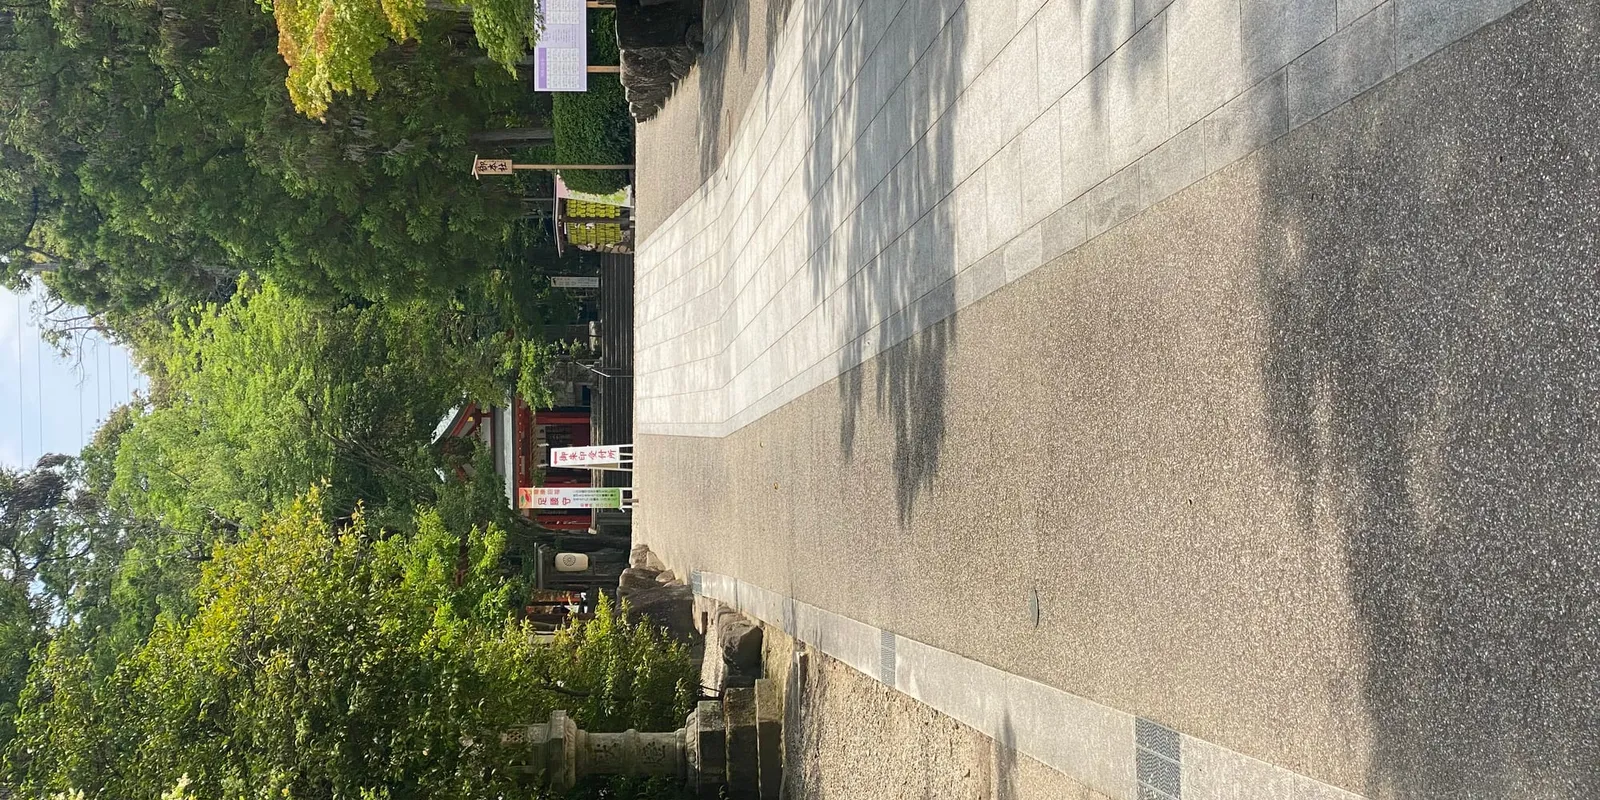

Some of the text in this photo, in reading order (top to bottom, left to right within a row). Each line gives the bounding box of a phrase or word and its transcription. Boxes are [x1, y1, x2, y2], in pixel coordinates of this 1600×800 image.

[478, 161, 507, 172] 御本社
[559, 449, 616, 461] 御朱印受付所
